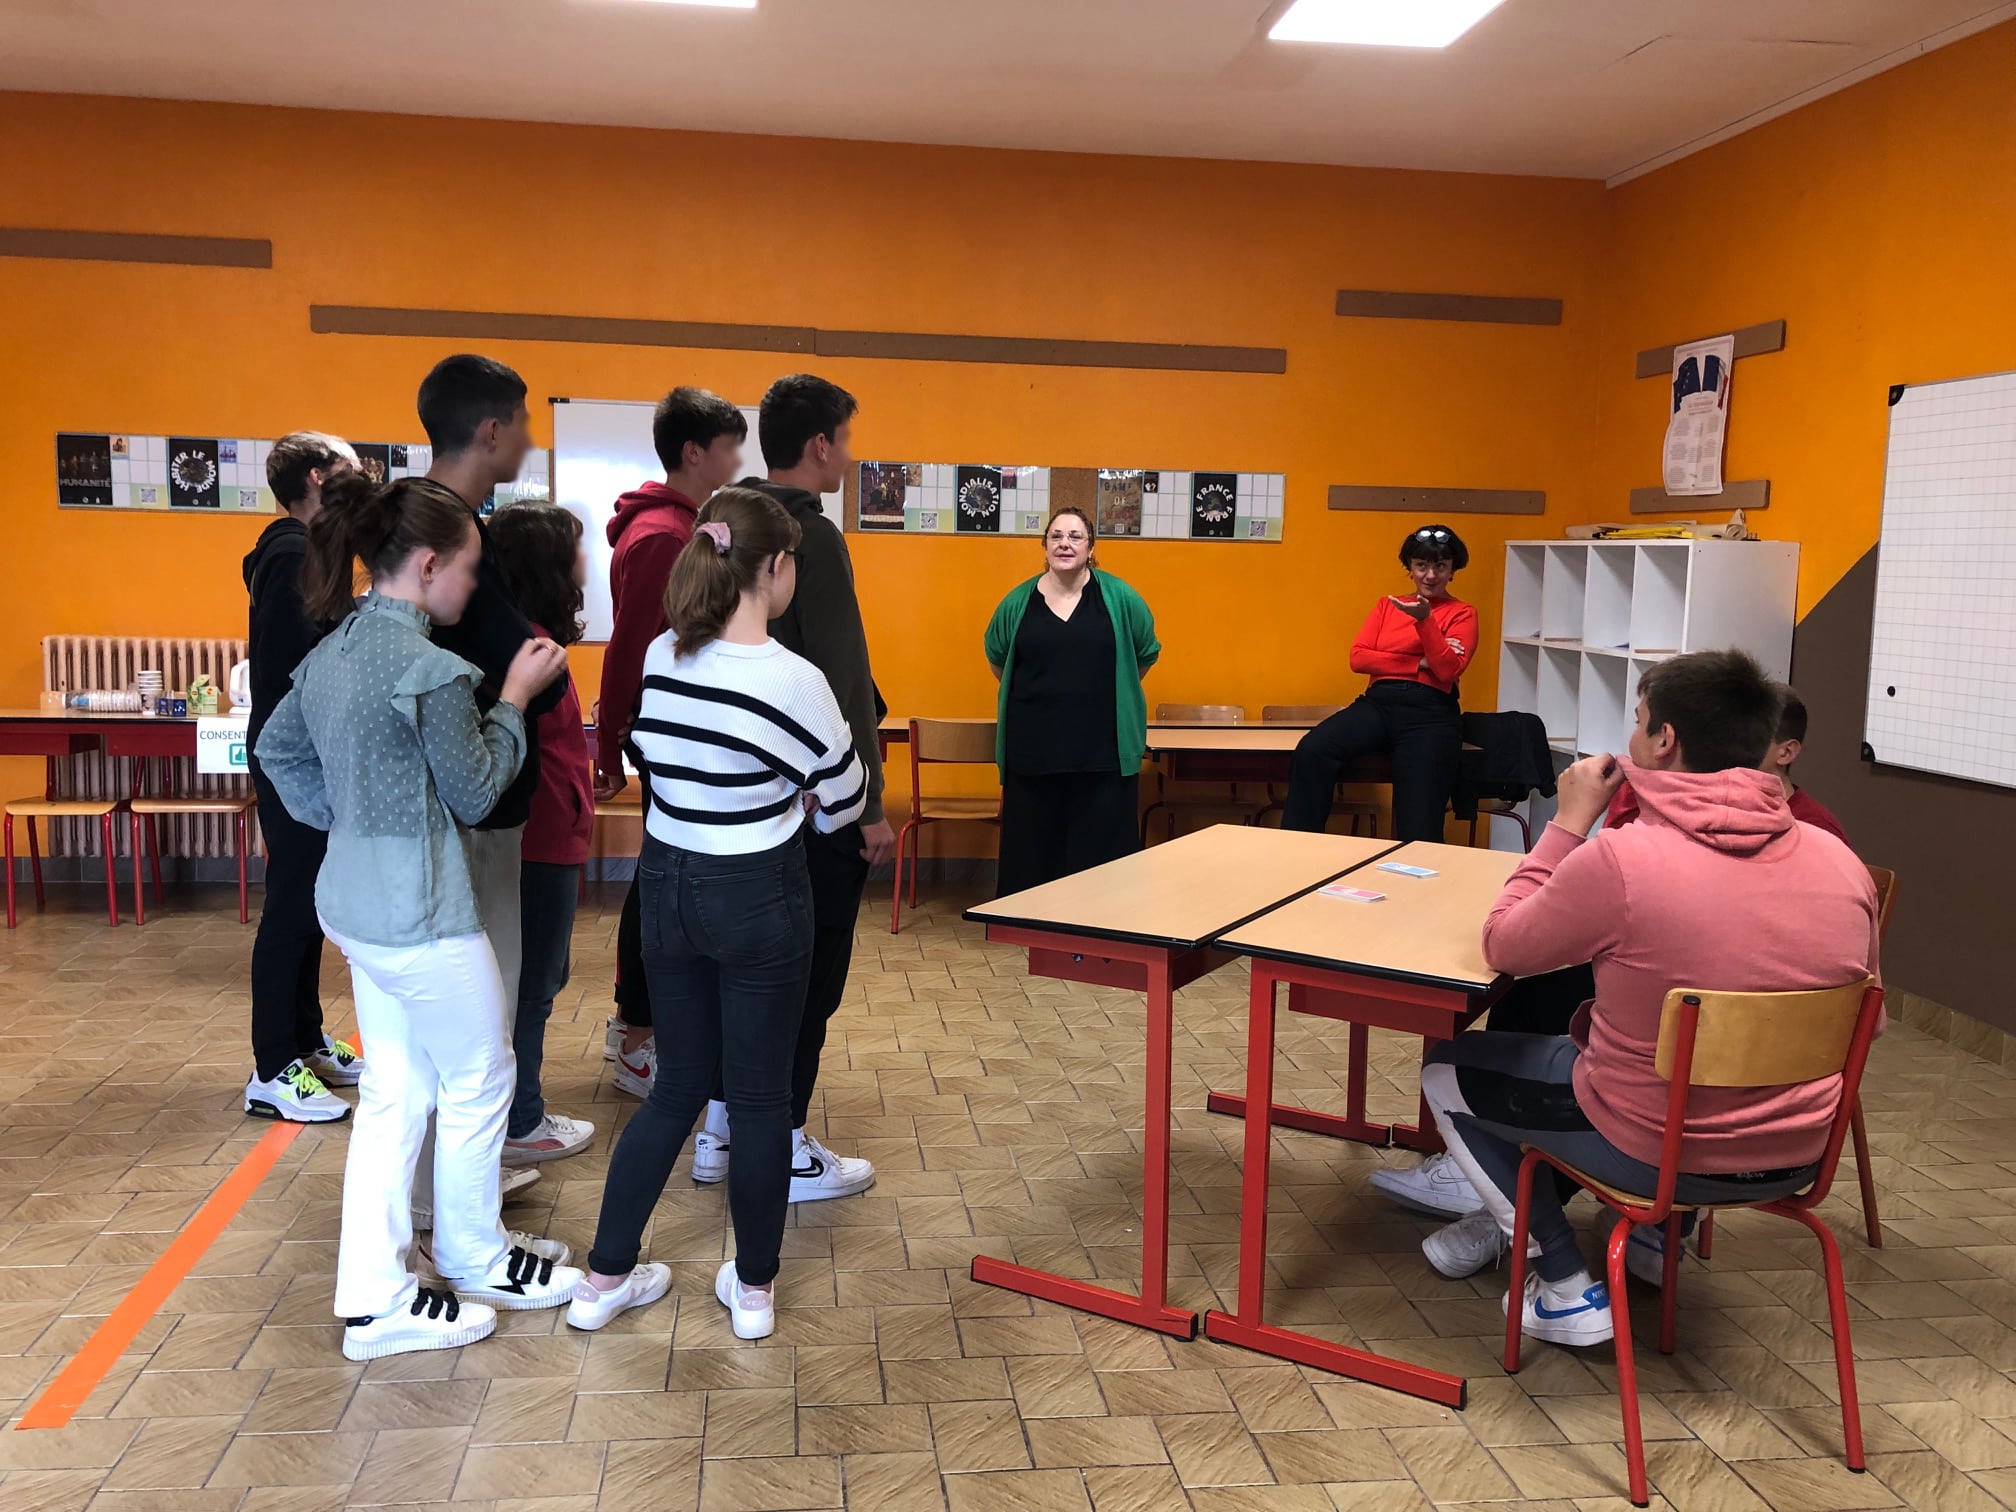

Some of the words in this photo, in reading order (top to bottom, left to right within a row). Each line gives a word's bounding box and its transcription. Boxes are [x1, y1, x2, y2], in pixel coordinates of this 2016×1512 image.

[192, 449, 206, 460] LE
[170, 451, 189, 492] HABITER
[196, 459, 217, 494] MONDE
[59, 477, 111, 488] HUMANITÉ
[958, 476, 999, 518] MONDIALISATION
[1196, 483, 1234, 502] FRANCE
[1195, 505, 1234, 523] FRANCE
